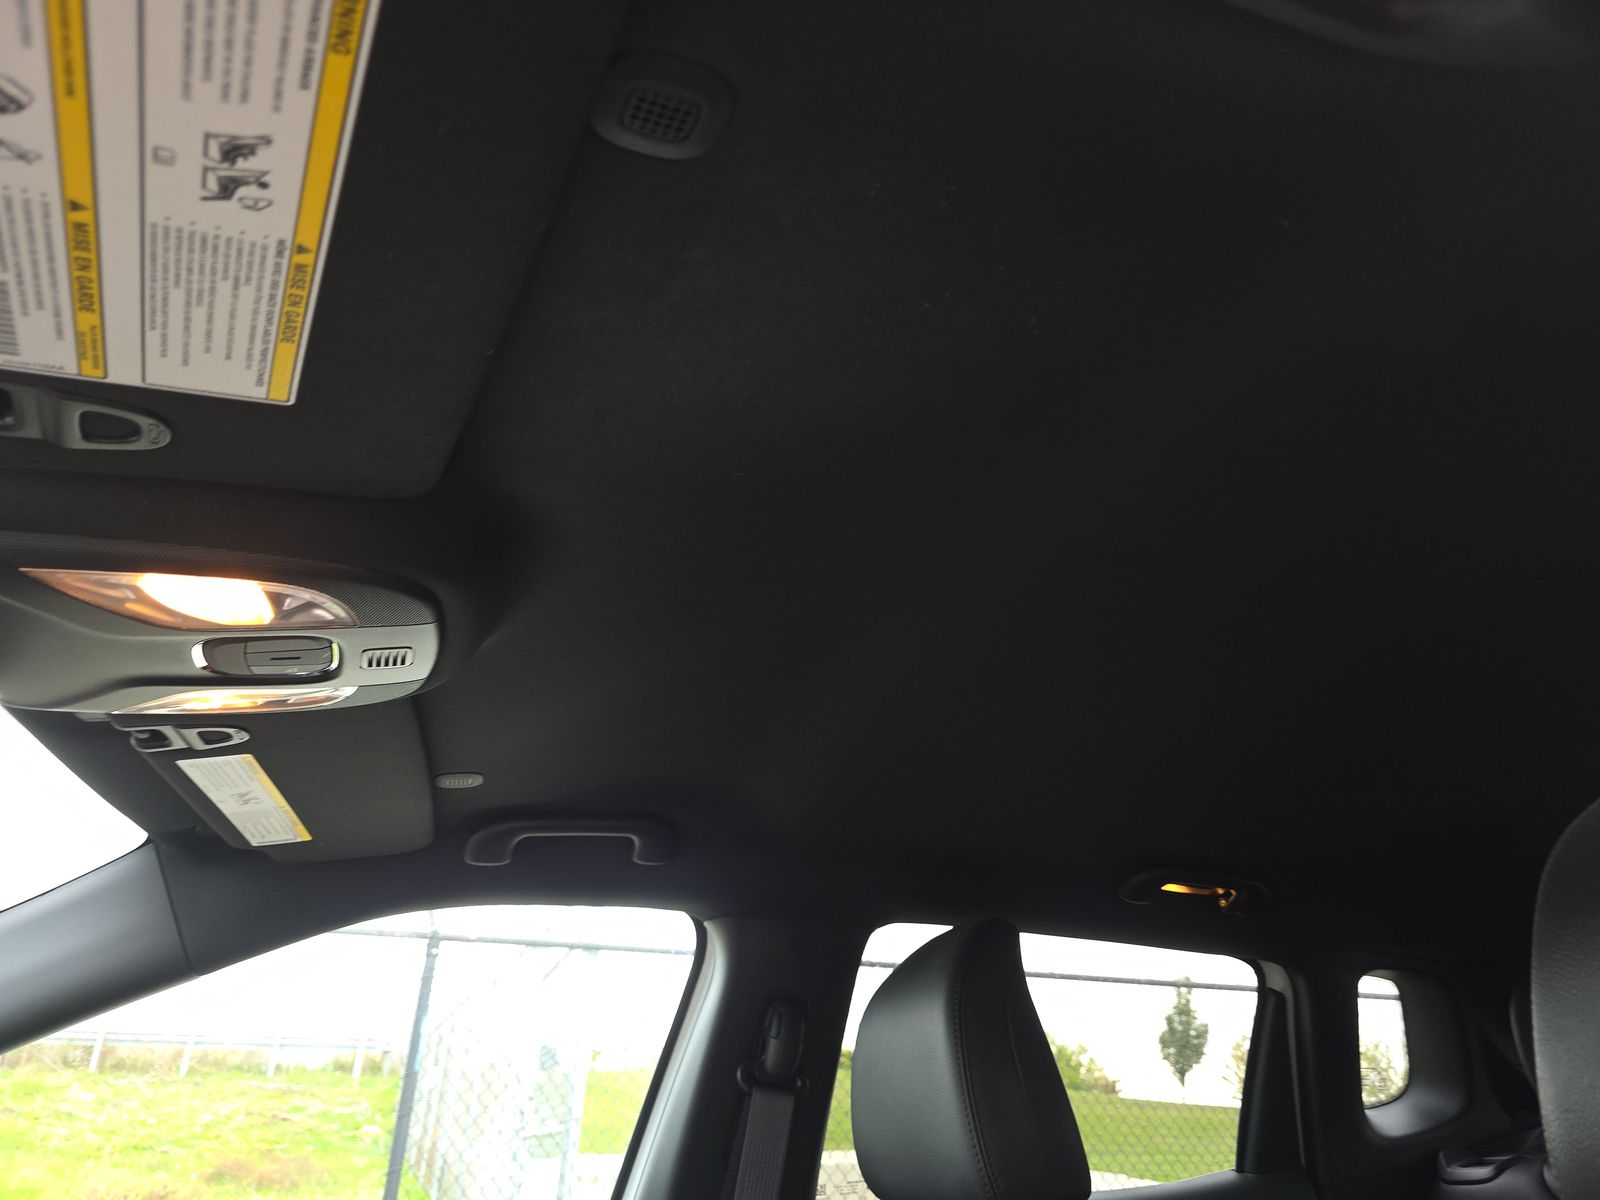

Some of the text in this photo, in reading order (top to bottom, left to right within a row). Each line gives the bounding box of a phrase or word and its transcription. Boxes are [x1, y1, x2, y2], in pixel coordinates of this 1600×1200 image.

[72, 222, 92, 253] MISE
[75, 256, 94, 272] EN
[77, 276, 97, 313] GARDE
[280, 263, 311, 344] MISE EN GARDE
